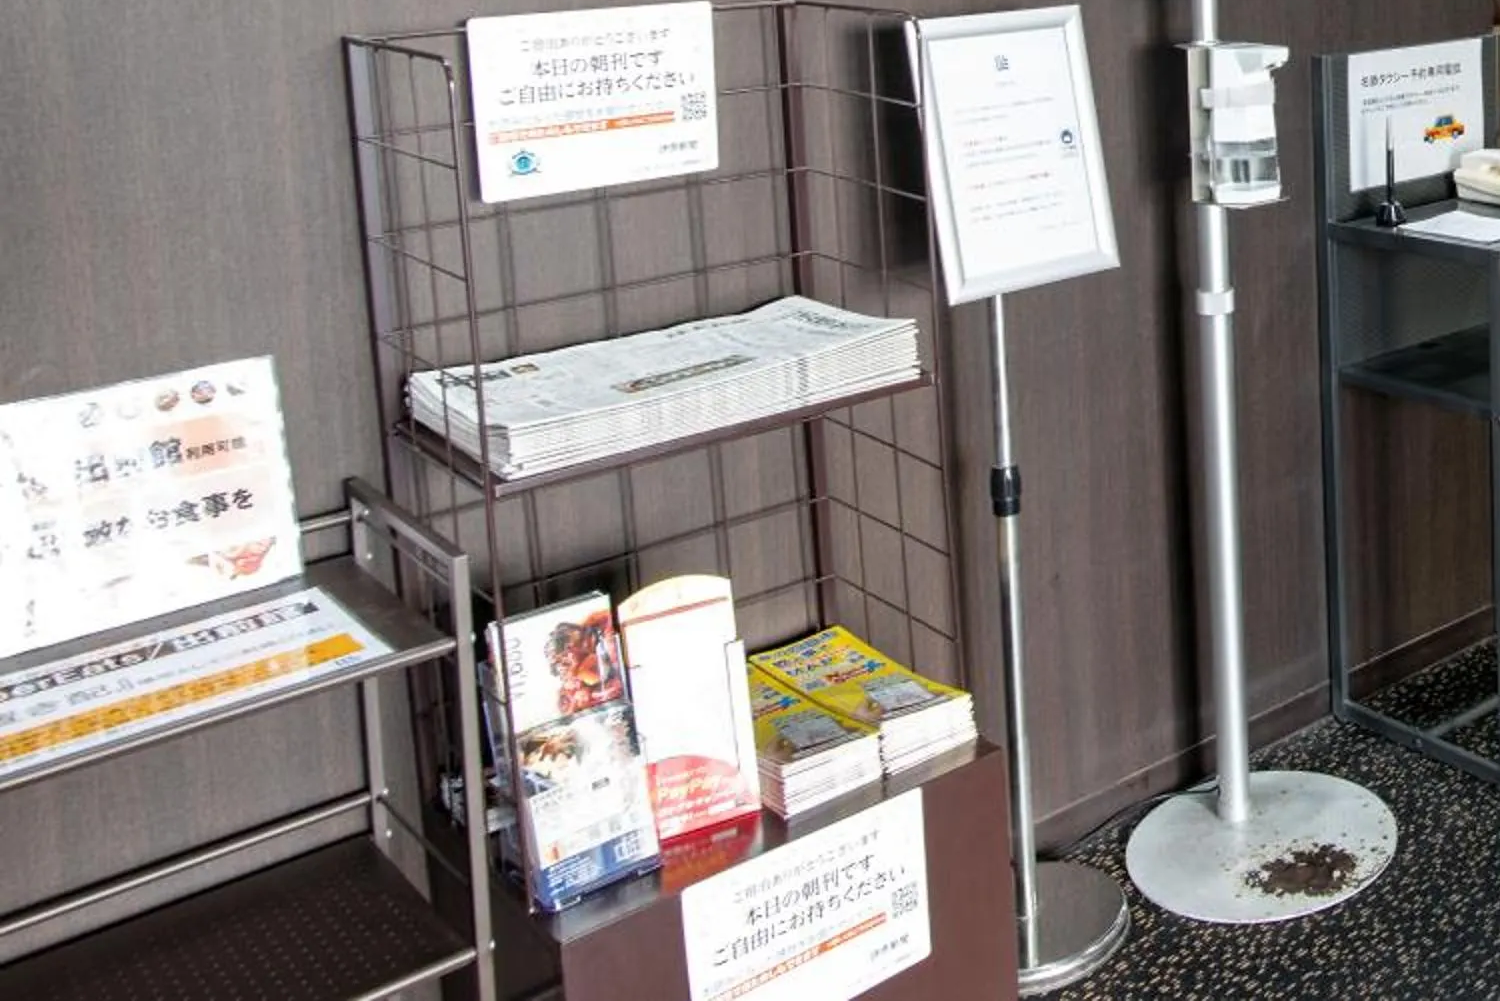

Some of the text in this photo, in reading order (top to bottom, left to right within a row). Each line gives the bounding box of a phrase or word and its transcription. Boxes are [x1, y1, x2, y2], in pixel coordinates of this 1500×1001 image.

[499, 70, 695, 106] ご自由にお持ちください
[532, 49, 664, 78] 本日の朝刊です
[712, 866, 906, 967] ご自由にお持ちください
[746, 854, 875, 926] 本日の朝刊です
